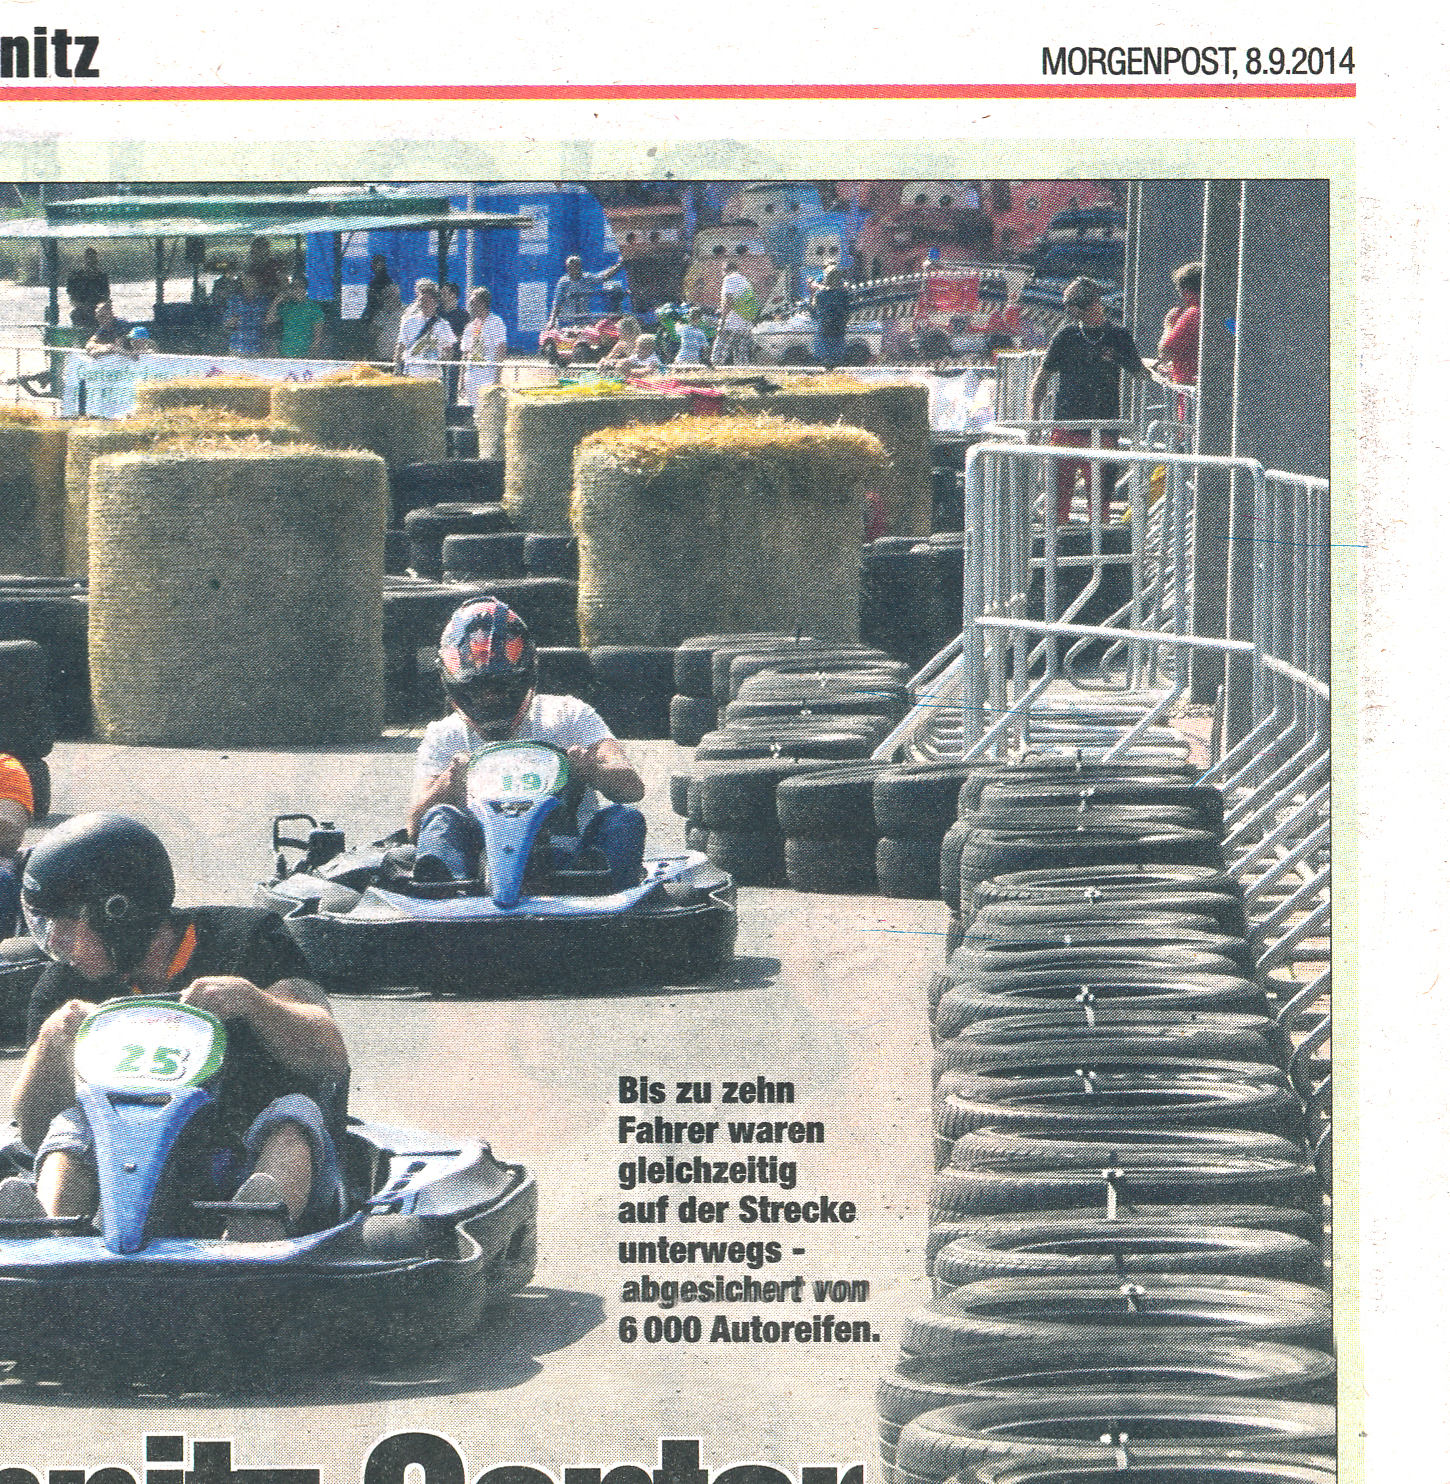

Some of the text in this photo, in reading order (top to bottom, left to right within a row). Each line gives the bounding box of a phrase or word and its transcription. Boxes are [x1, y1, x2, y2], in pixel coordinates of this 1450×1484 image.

[1041, 46, 1356, 80] MORGENPOST, 8.9.2014
[501, 771, 542, 792] 19
[113, 1043, 183, 1076] 25
[619, 1076, 794, 1104] Bis zu zehn
[619, 1116, 824, 1144] Fahrer waren
[619, 1156, 796, 1190] gleichzeitig
[618, 1195, 856, 1223] auf der Strecke
[619, 1236, 781, 1269] unterwegs
[622, 1275, 871, 1309] abgesichert von
[711, 1315, 880, 1343] Autoreifen.
